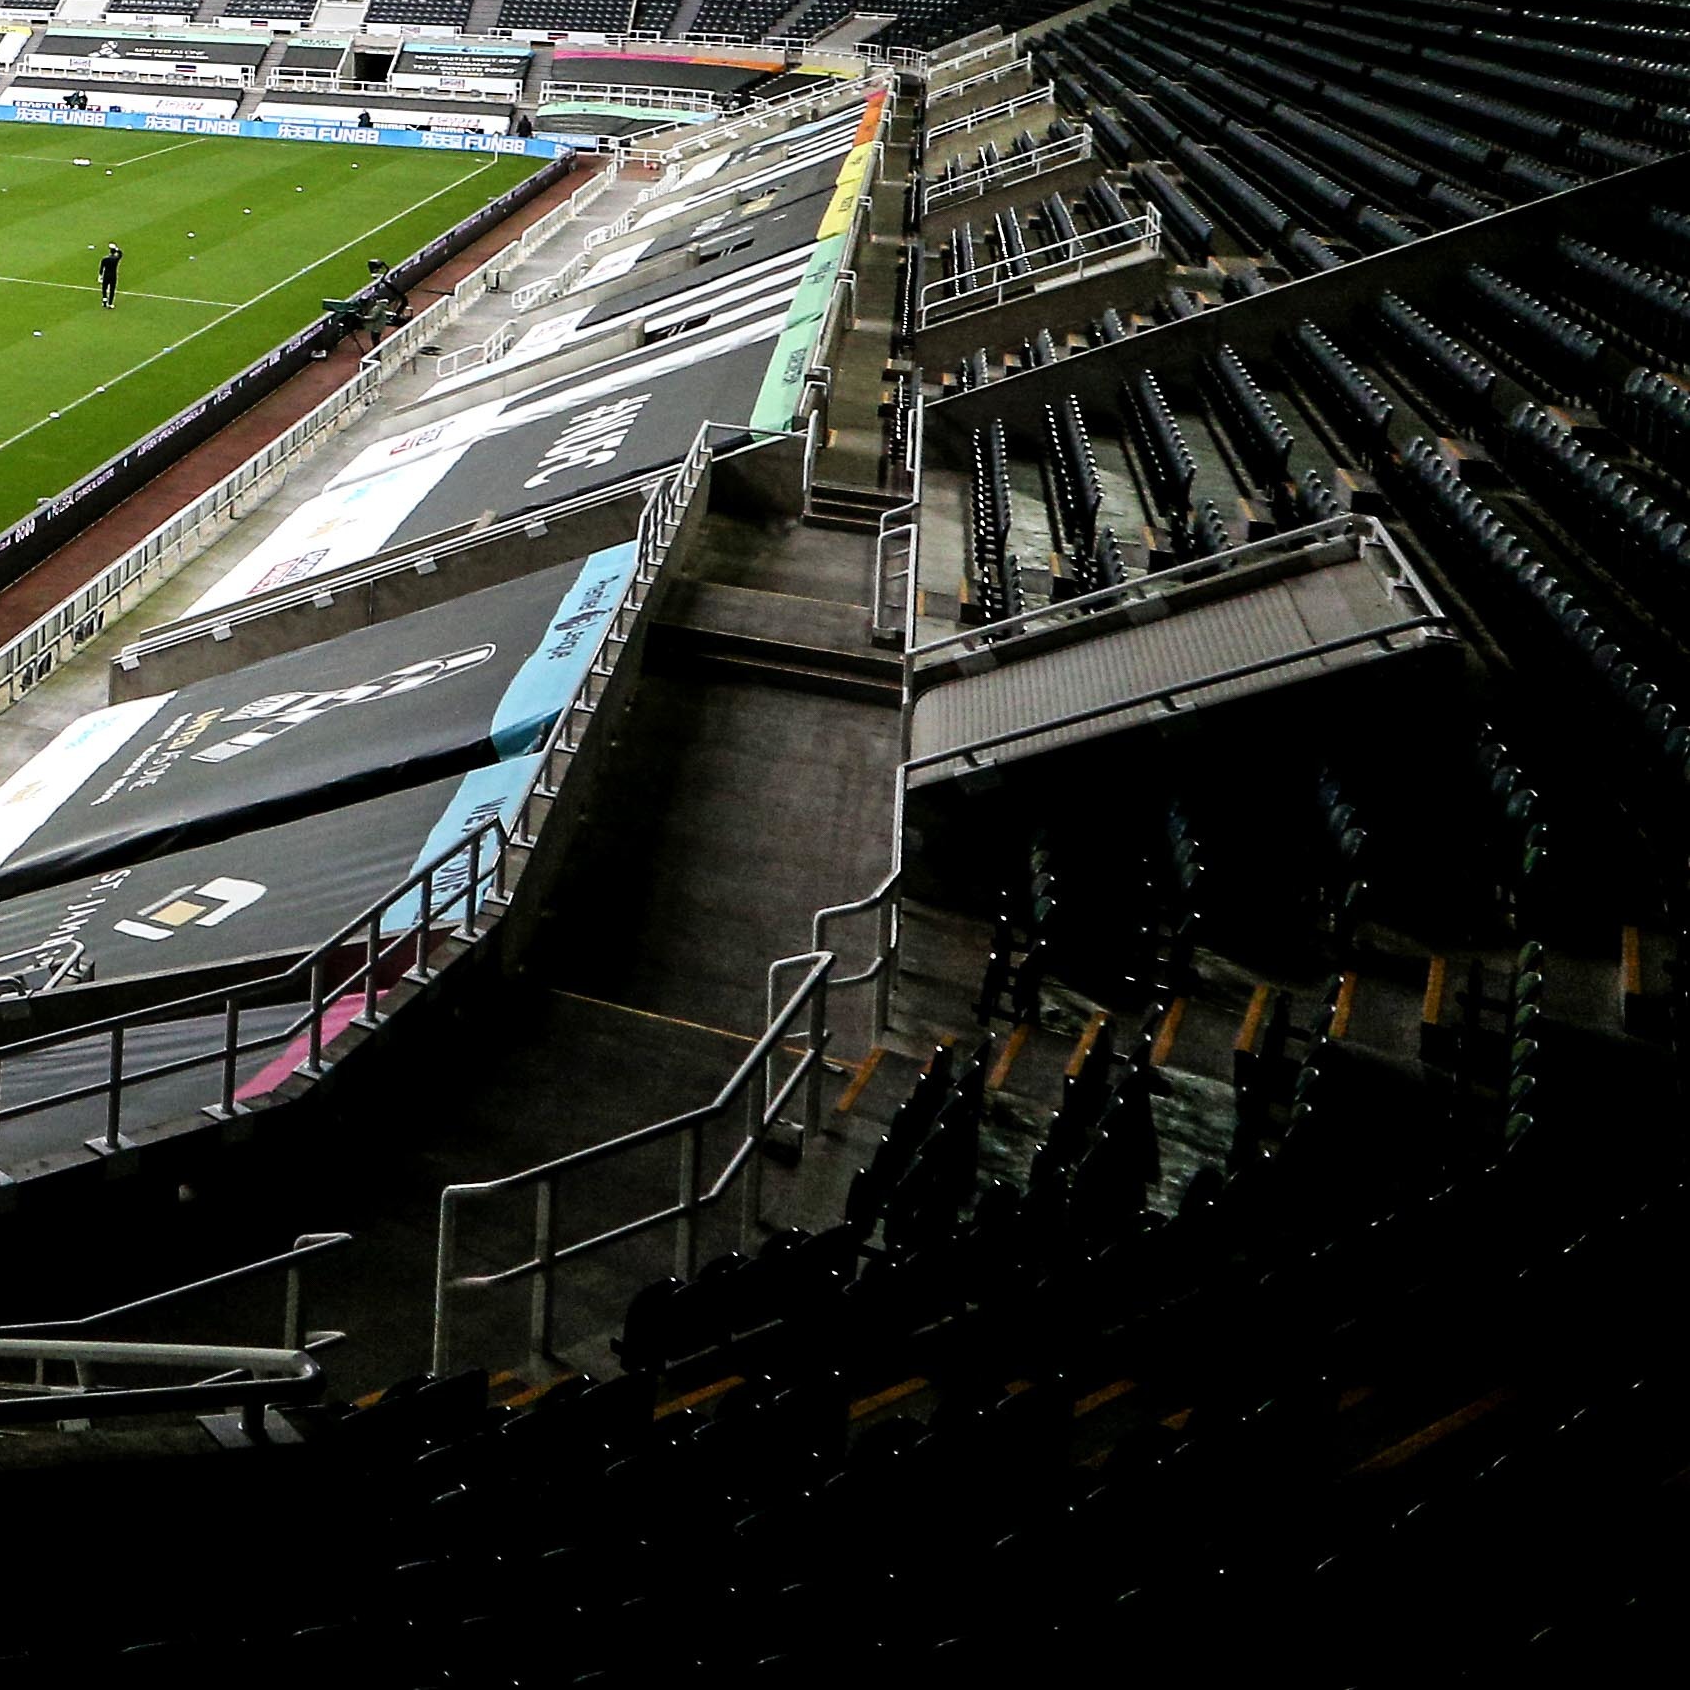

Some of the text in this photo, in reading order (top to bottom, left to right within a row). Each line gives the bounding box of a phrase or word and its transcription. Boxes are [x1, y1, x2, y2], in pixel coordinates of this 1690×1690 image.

[52, 109, 107, 127] FUN88
[182, 118, 241, 135] FUN88
[317, 126, 380, 144] FUN88
[463, 134, 526, 154] FUN88
[523, 393, 653, 490] #NUFC
[87, 868, 132, 898] ST.
